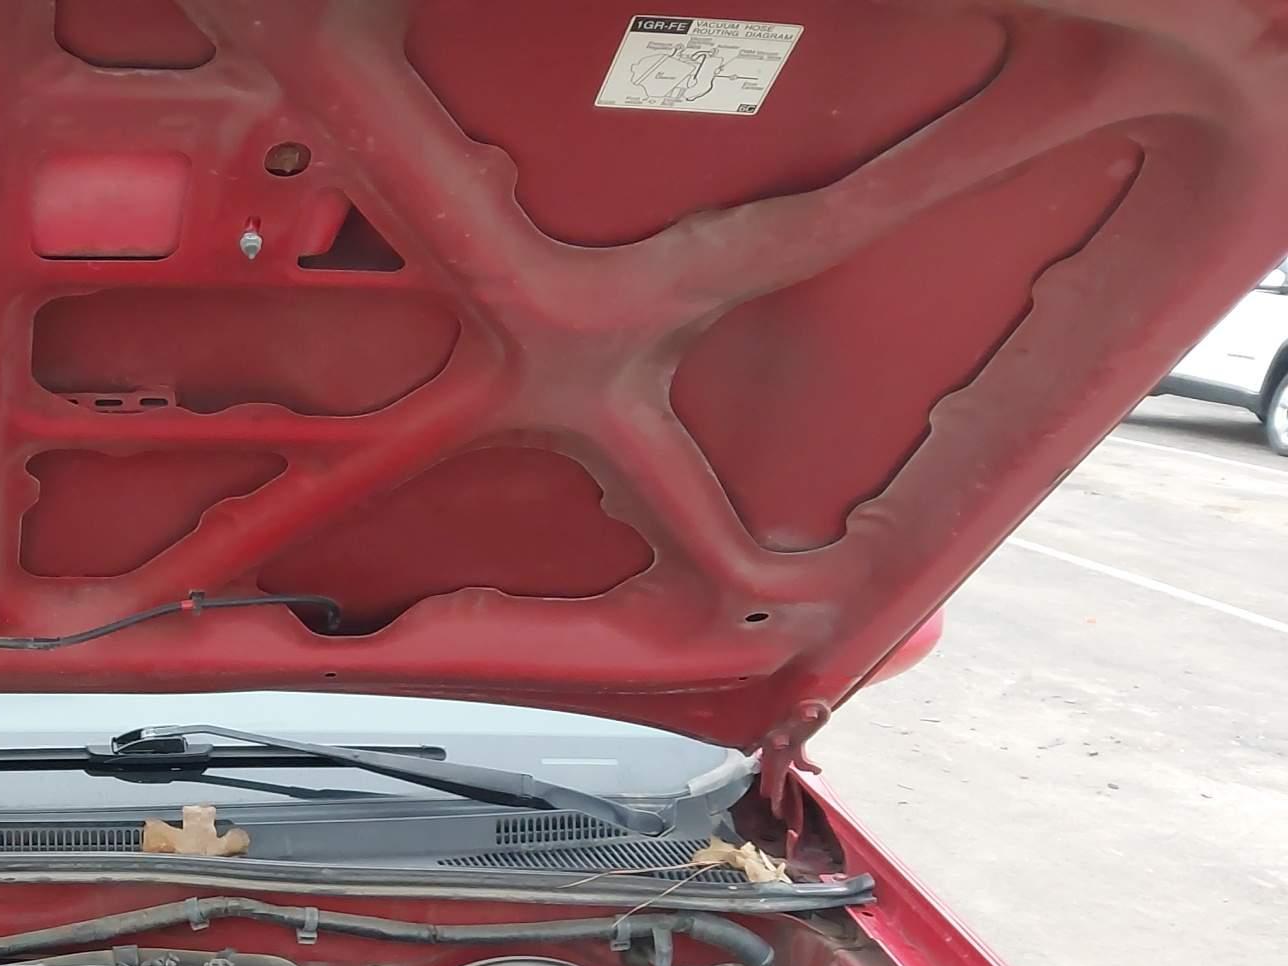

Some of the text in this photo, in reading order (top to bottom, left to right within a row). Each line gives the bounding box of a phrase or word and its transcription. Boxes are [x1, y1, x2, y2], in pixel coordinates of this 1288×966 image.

[637, 20, 774, 33] 1GR-FE VACUUM HOSE
[693, 28, 793, 40] ROUTING DIAGRAM
